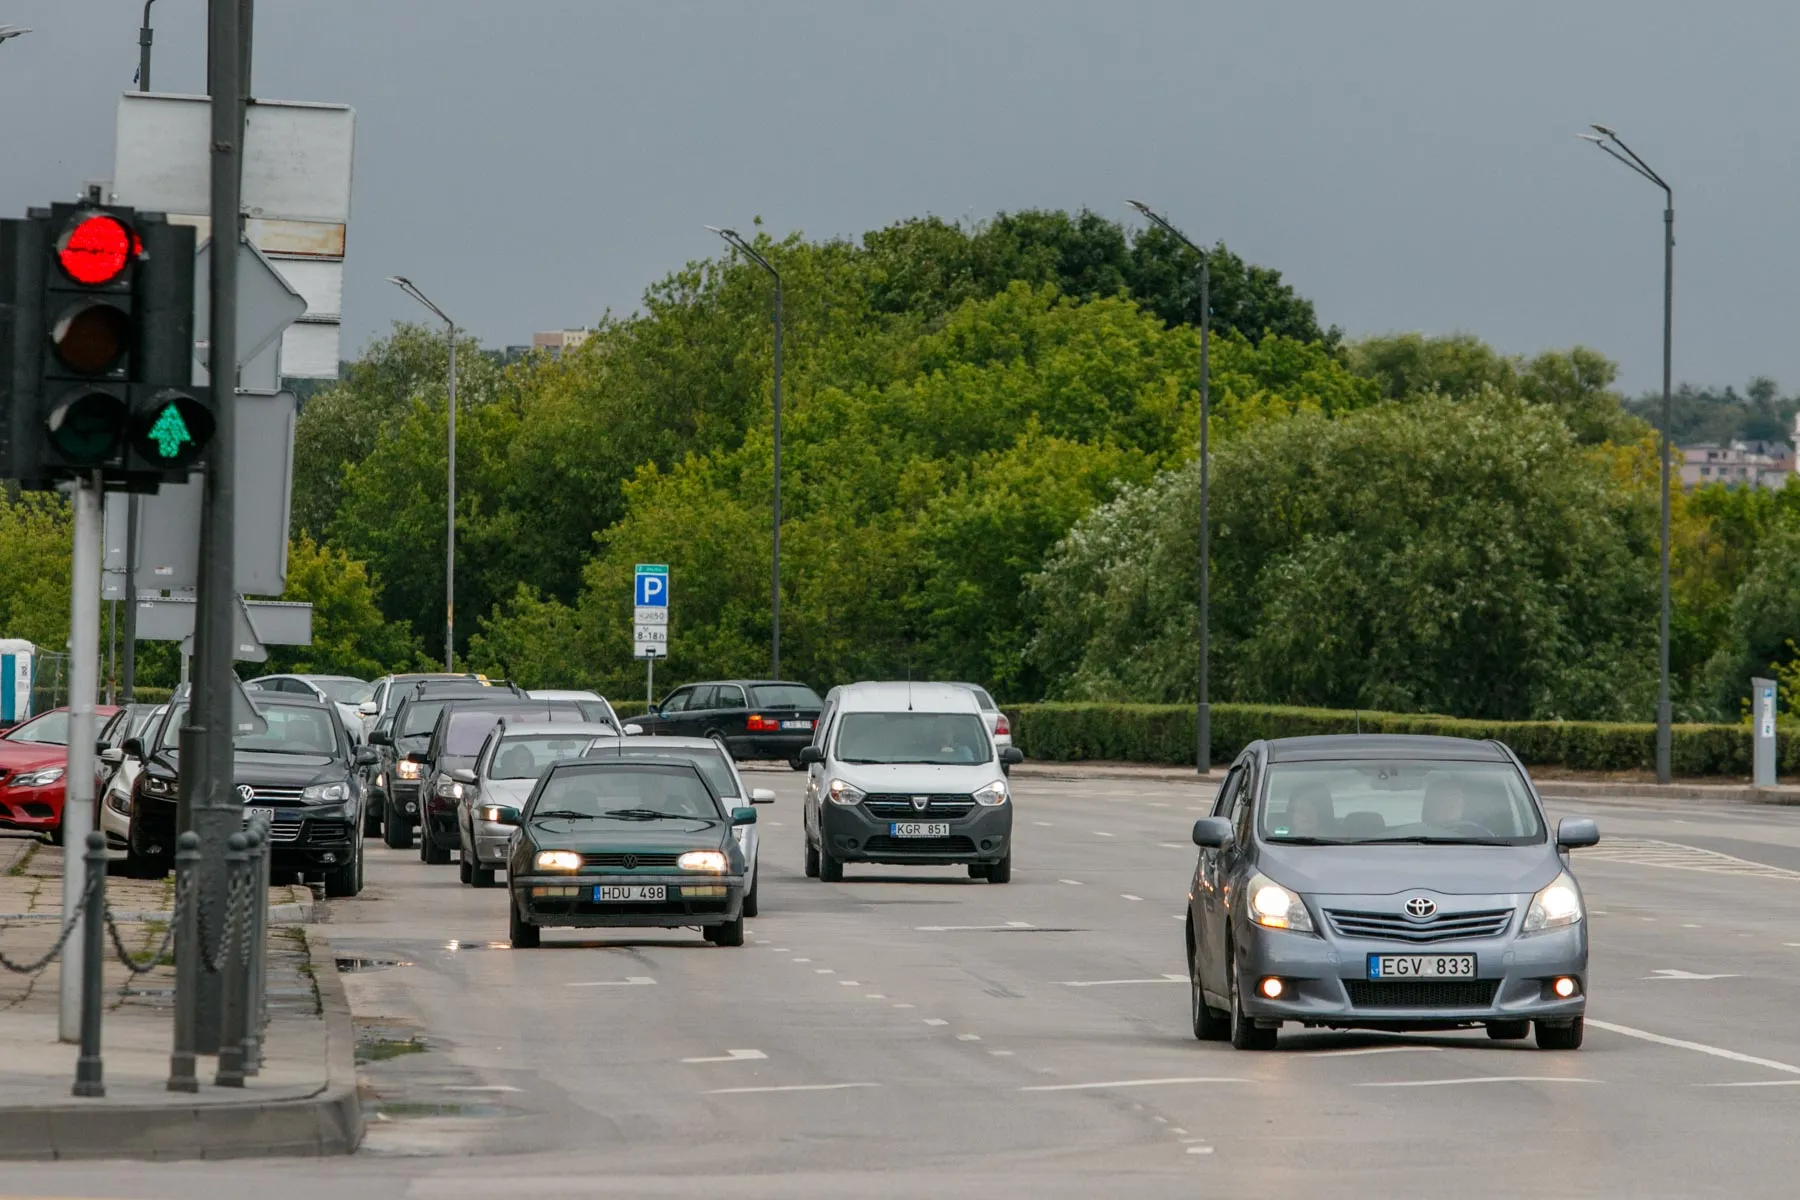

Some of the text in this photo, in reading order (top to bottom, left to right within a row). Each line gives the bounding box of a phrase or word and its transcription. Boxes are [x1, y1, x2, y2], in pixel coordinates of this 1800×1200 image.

[644, 577, 662, 603] P
[897, 824, 947, 834] KGR 851
[602, 887, 631, 899] HDU
[640, 887, 664, 899] 498
[1382, 958, 1422, 975] EGV
[1437, 958, 1470, 975] 833
